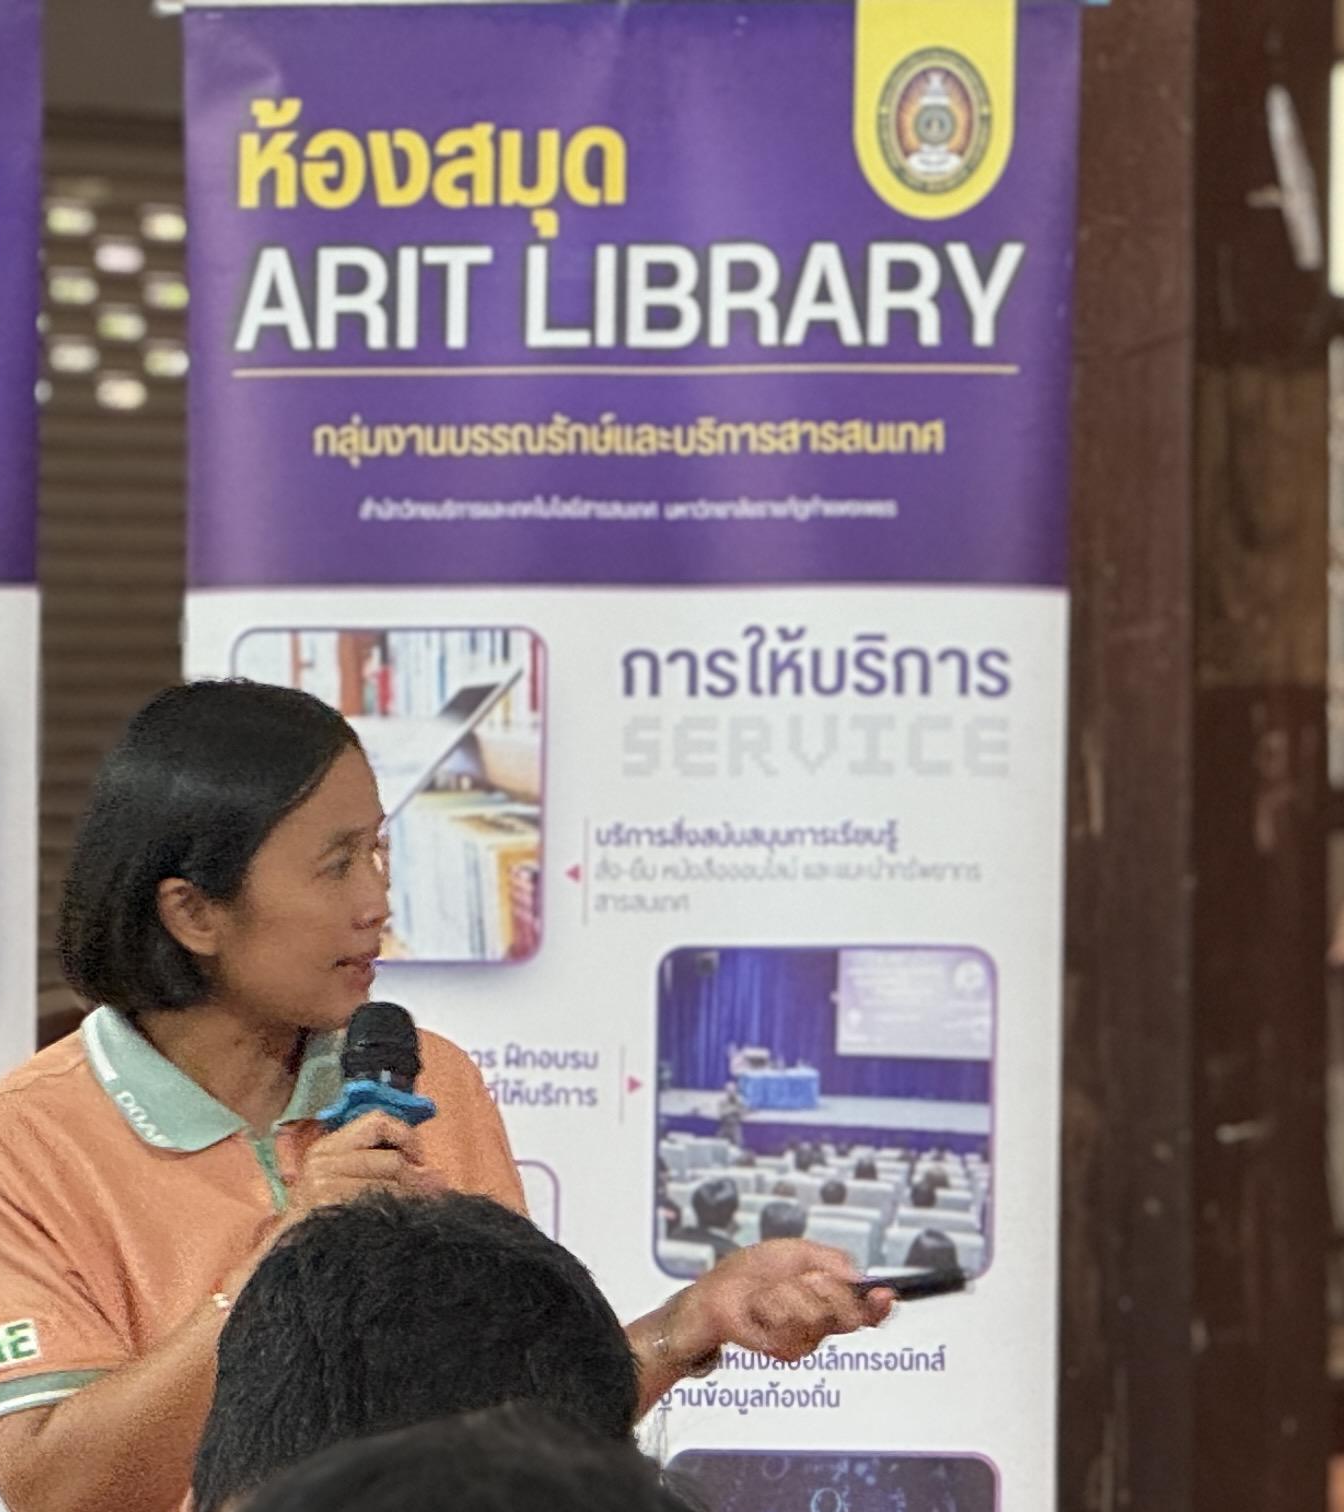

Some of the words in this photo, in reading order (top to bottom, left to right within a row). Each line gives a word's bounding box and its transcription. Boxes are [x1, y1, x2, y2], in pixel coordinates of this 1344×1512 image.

[238, 100, 627, 238] ห้องสมุด
[235, 246, 493, 351] ARIT
[524, 242, 1025, 348] LIBRARY
[313, 414, 945, 468] กลุ่มงานบรรณรักษ์และบริการสารสนเทศ
[621, 626, 1012, 699] การให้บริการ
[621, 715, 1011, 777] SERVICE
